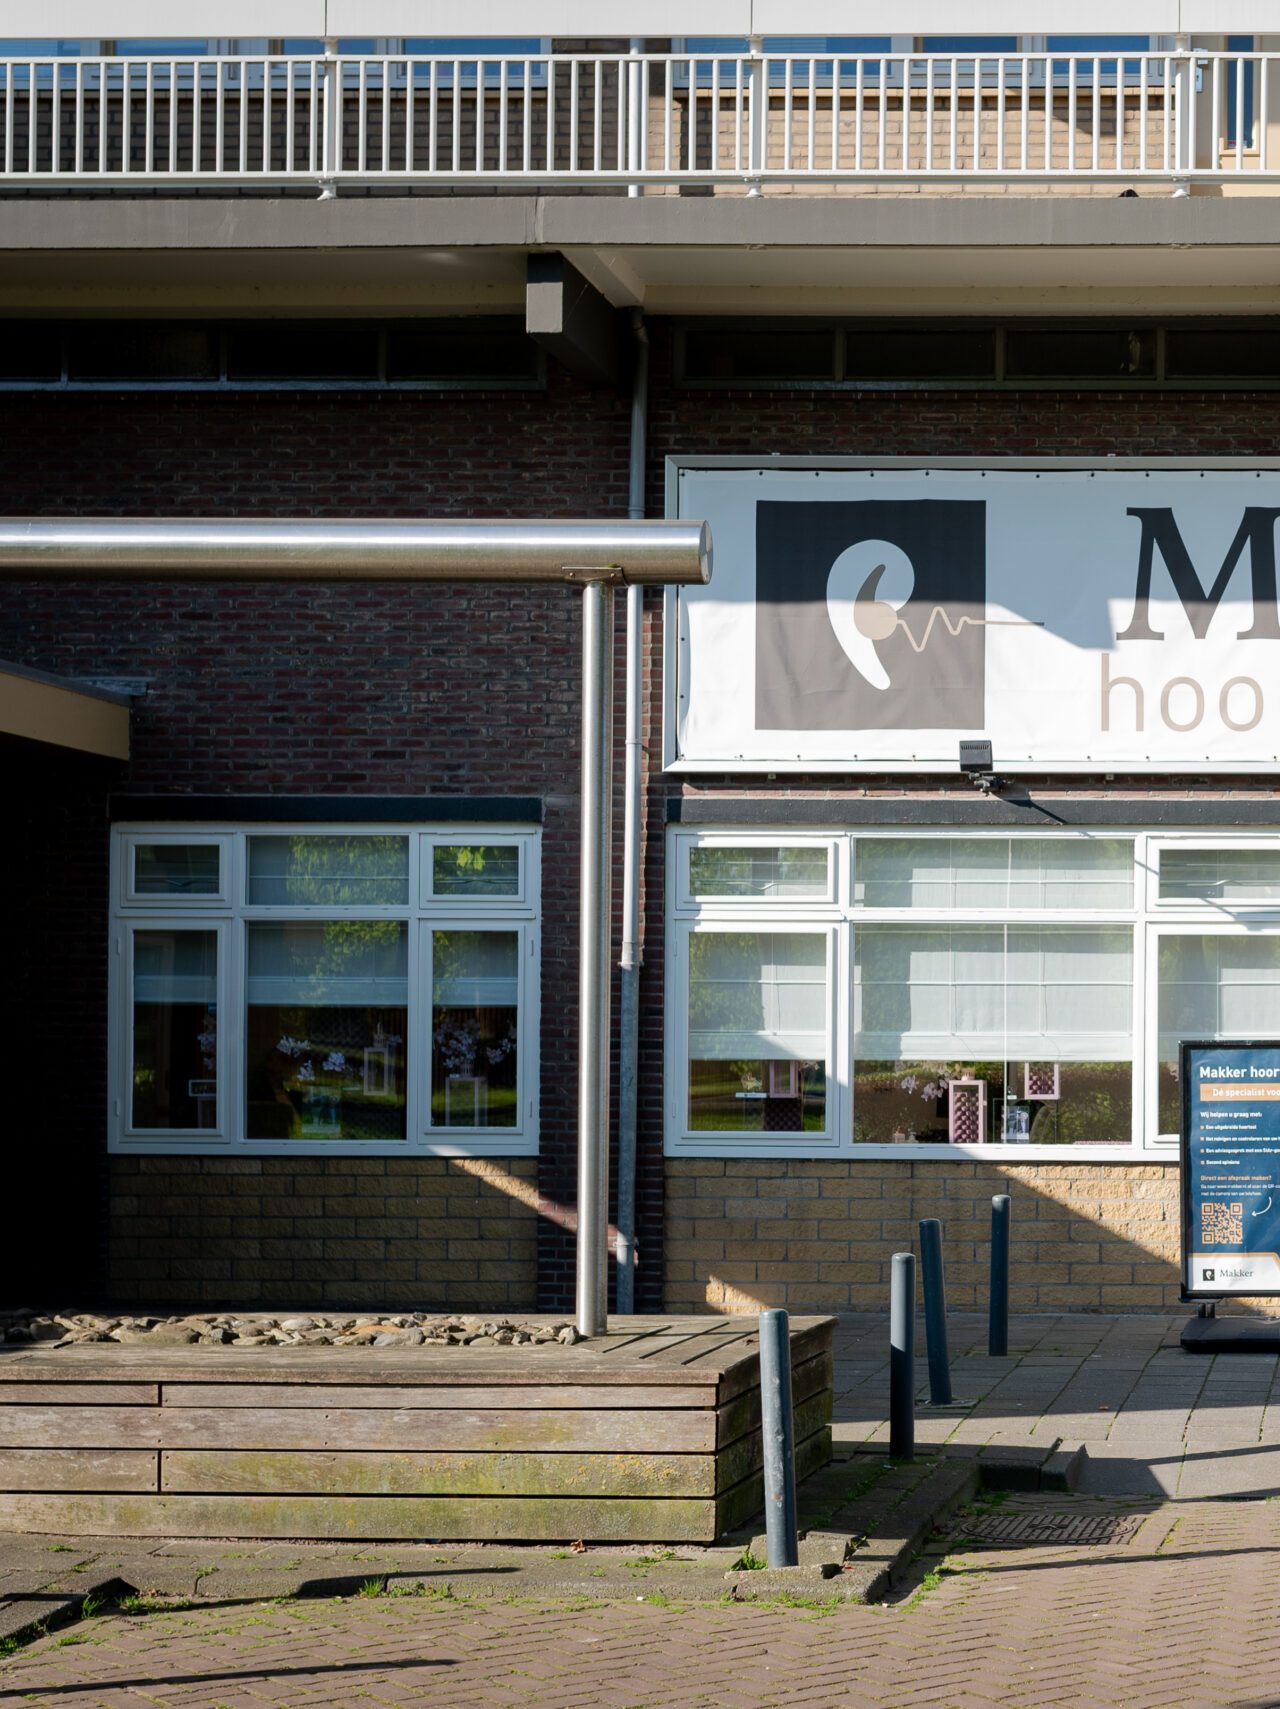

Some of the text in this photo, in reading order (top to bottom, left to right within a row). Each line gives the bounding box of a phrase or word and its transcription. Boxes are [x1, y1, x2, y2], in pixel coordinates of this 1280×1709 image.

[1199, 1066, 1247, 1078] Makker
[1225, 1087, 1265, 1099] specialist
[1219, 1268, 1254, 1278] Makker
